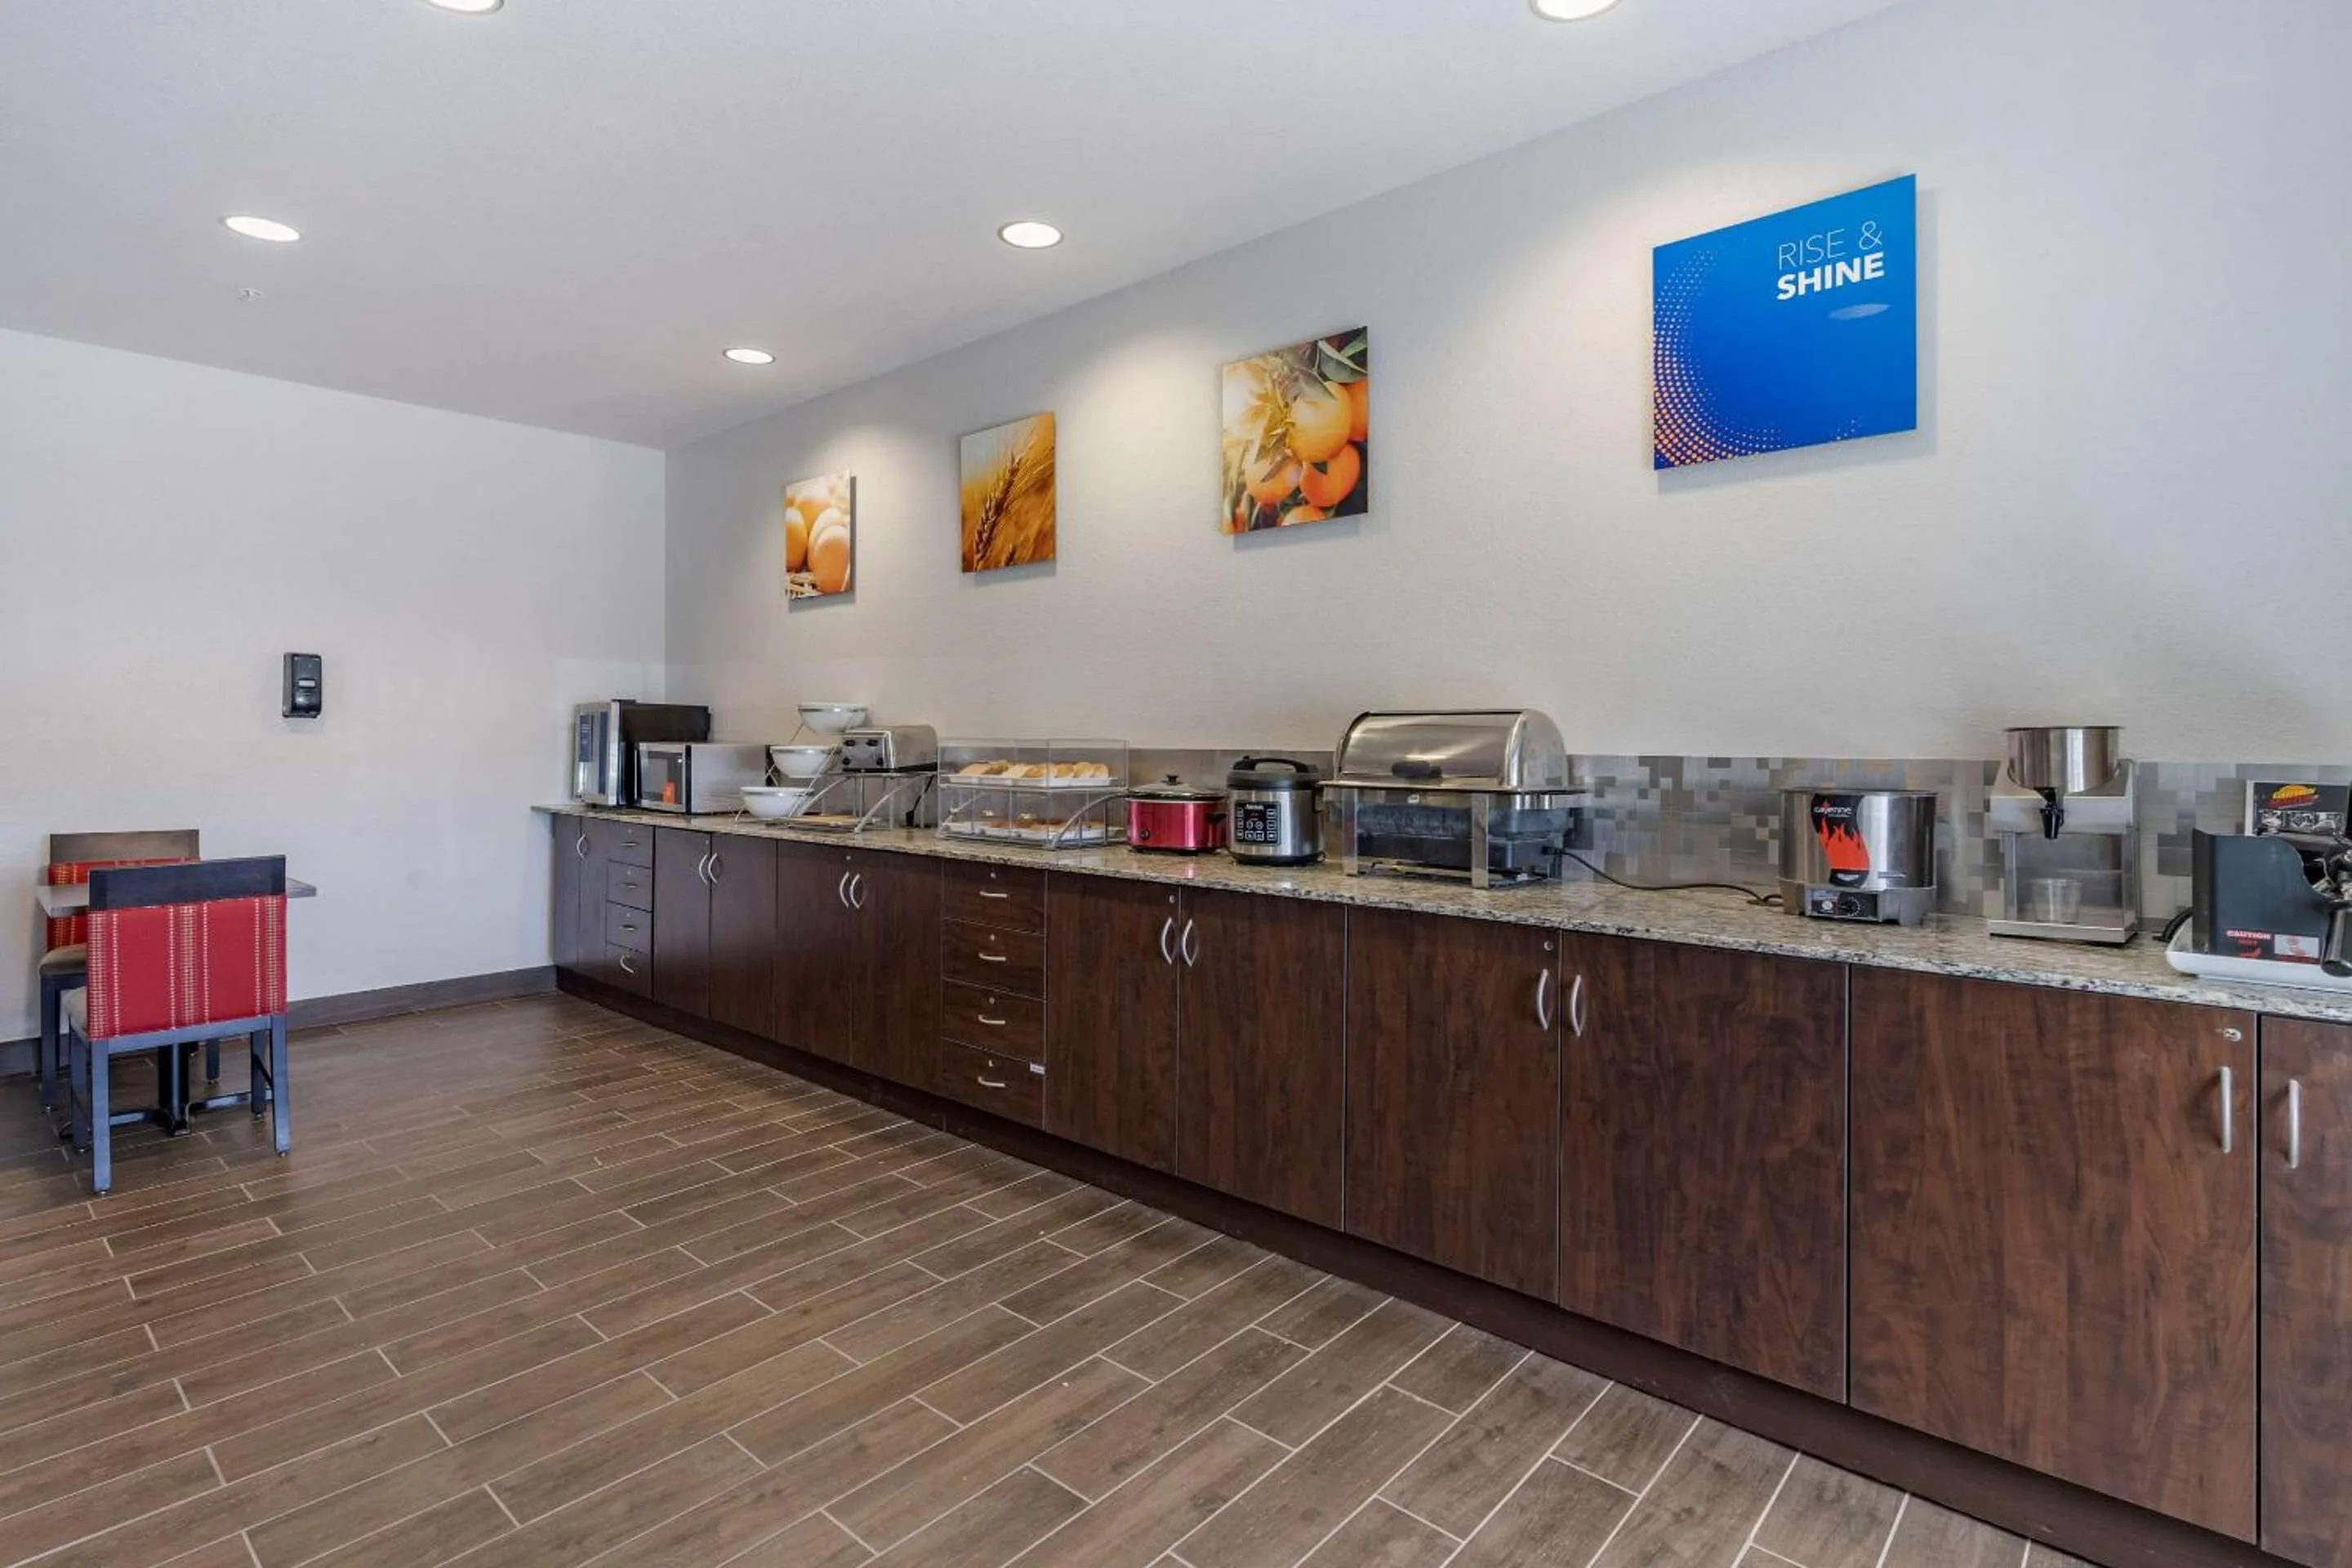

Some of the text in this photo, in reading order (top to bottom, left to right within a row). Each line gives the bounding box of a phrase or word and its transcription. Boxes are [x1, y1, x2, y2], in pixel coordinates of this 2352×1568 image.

[1779, 220, 1883, 270] RISE &
[1776, 251, 1885, 301] SHINE
